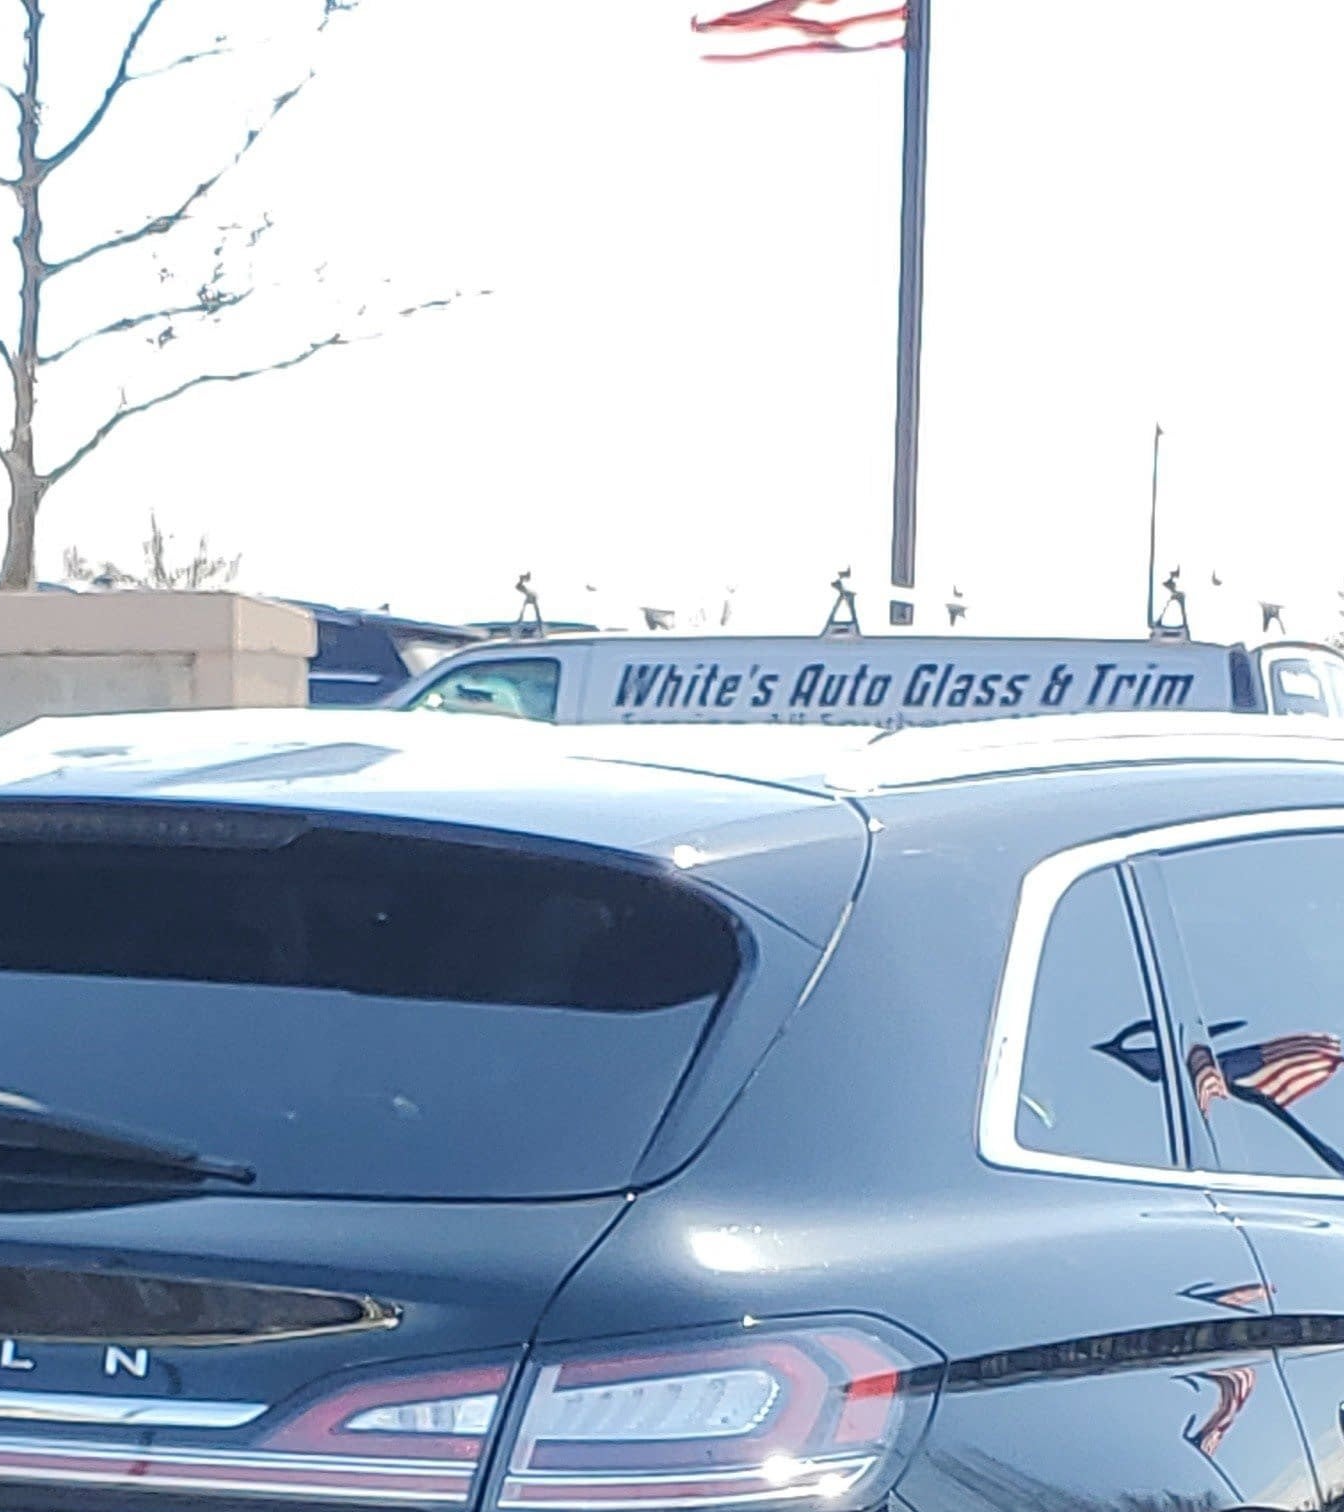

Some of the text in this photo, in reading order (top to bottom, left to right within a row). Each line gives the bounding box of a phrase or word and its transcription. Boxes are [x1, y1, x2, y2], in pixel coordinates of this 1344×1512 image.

[614, 662, 1195, 708] White's Auto Glass & Trim
